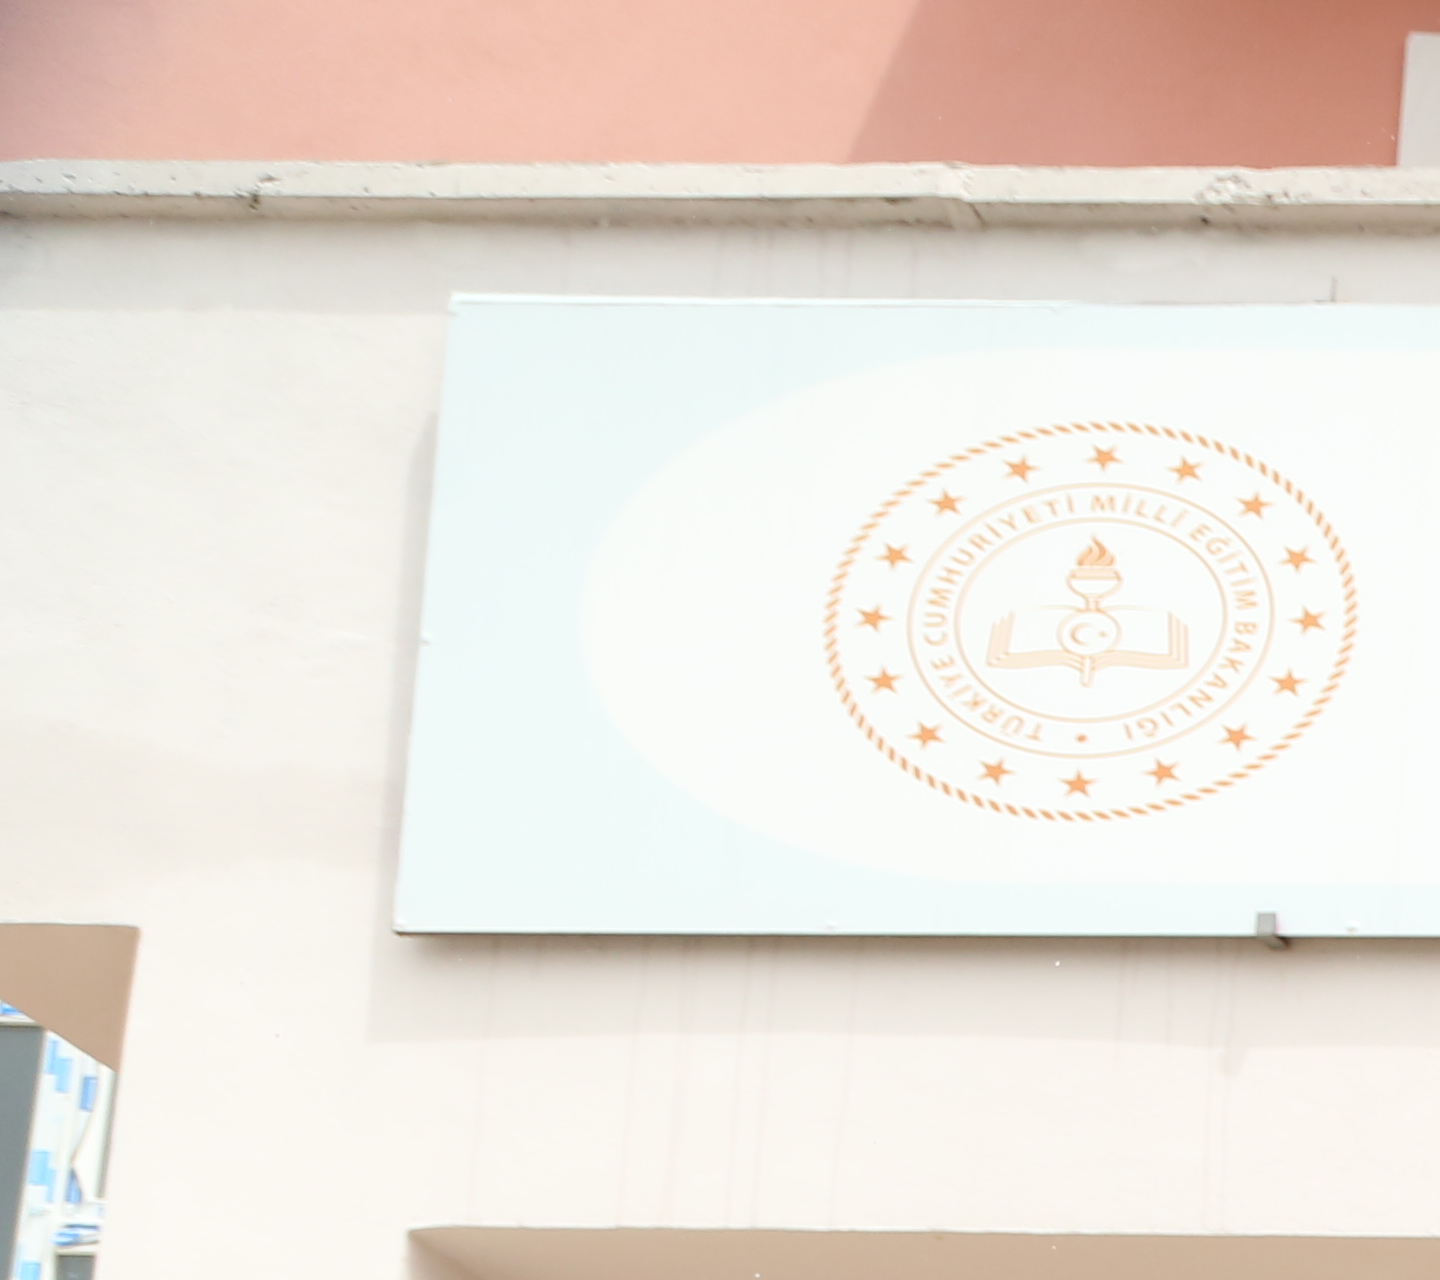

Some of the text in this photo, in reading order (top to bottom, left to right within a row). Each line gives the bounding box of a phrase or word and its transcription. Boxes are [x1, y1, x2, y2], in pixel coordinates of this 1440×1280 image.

[922, 491, 1260, 744] TÜRKİYE CUMHURİYETİ MİLLİ EĞİTİM BAKANLIĞI
